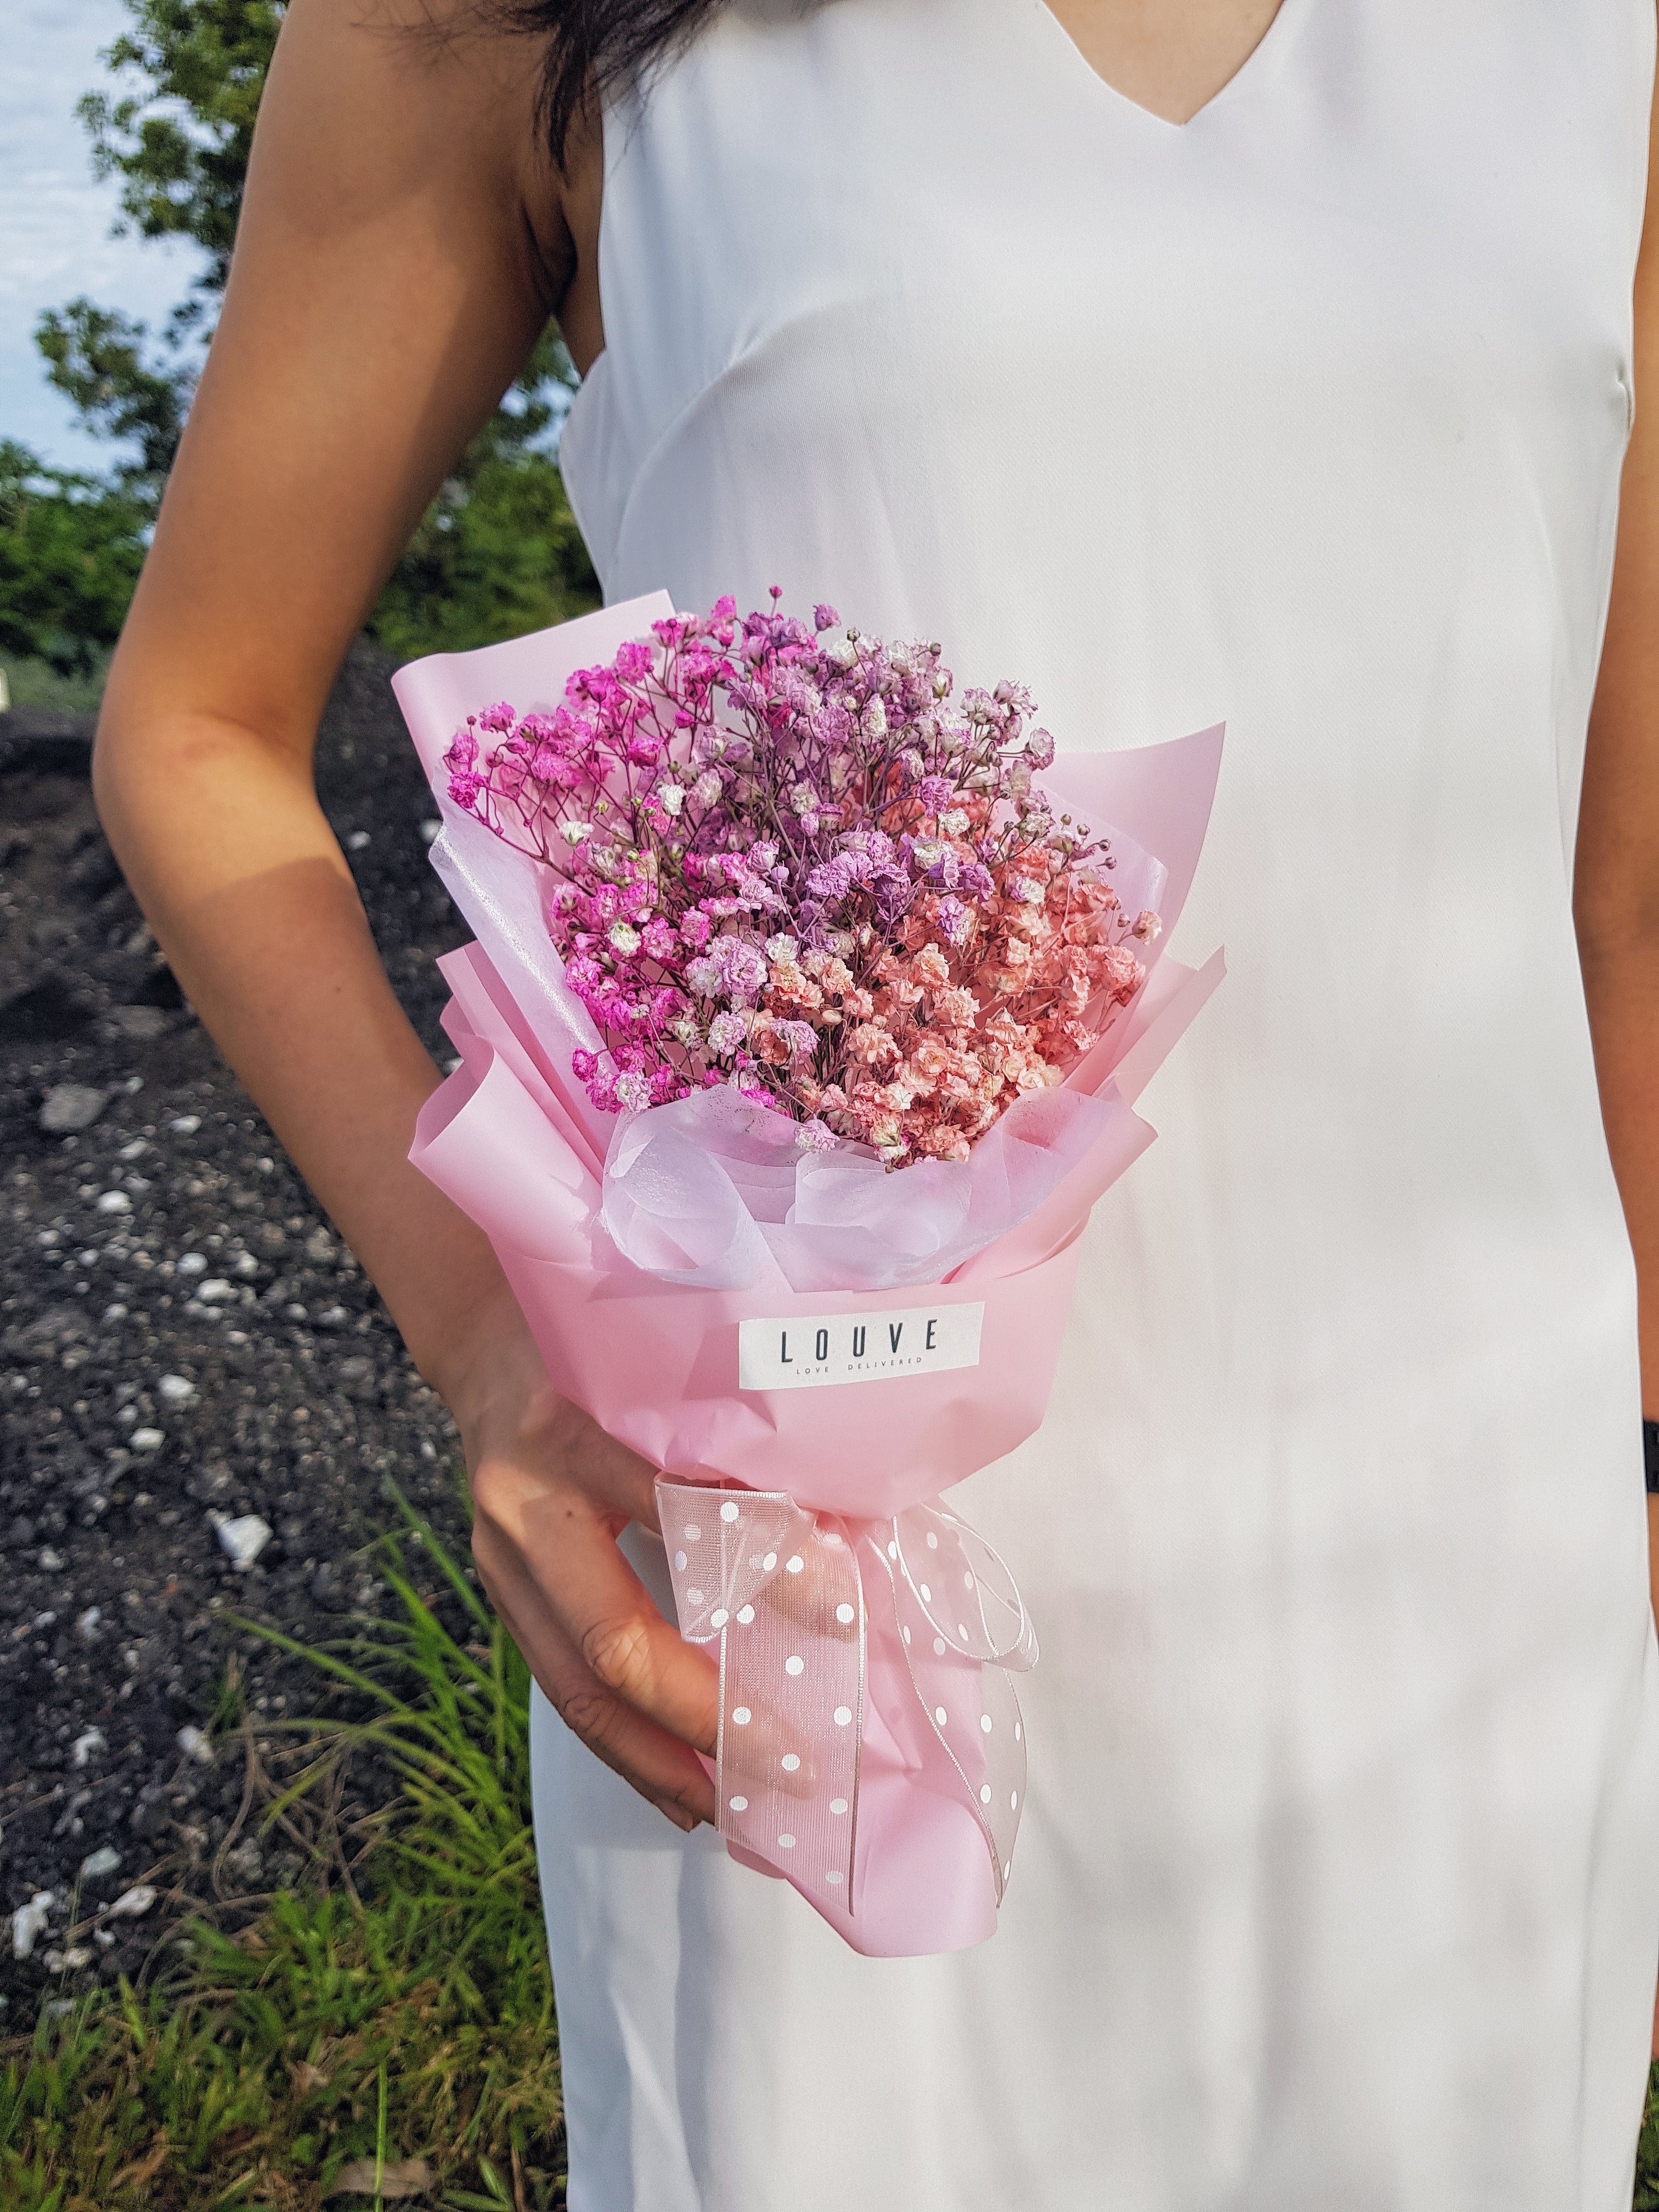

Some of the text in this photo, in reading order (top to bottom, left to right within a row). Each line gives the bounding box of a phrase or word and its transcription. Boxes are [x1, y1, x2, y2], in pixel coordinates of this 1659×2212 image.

[781, 1319, 938, 1363] LOUVE
[797, 1357, 922, 1375] LOVE DELIVERED
